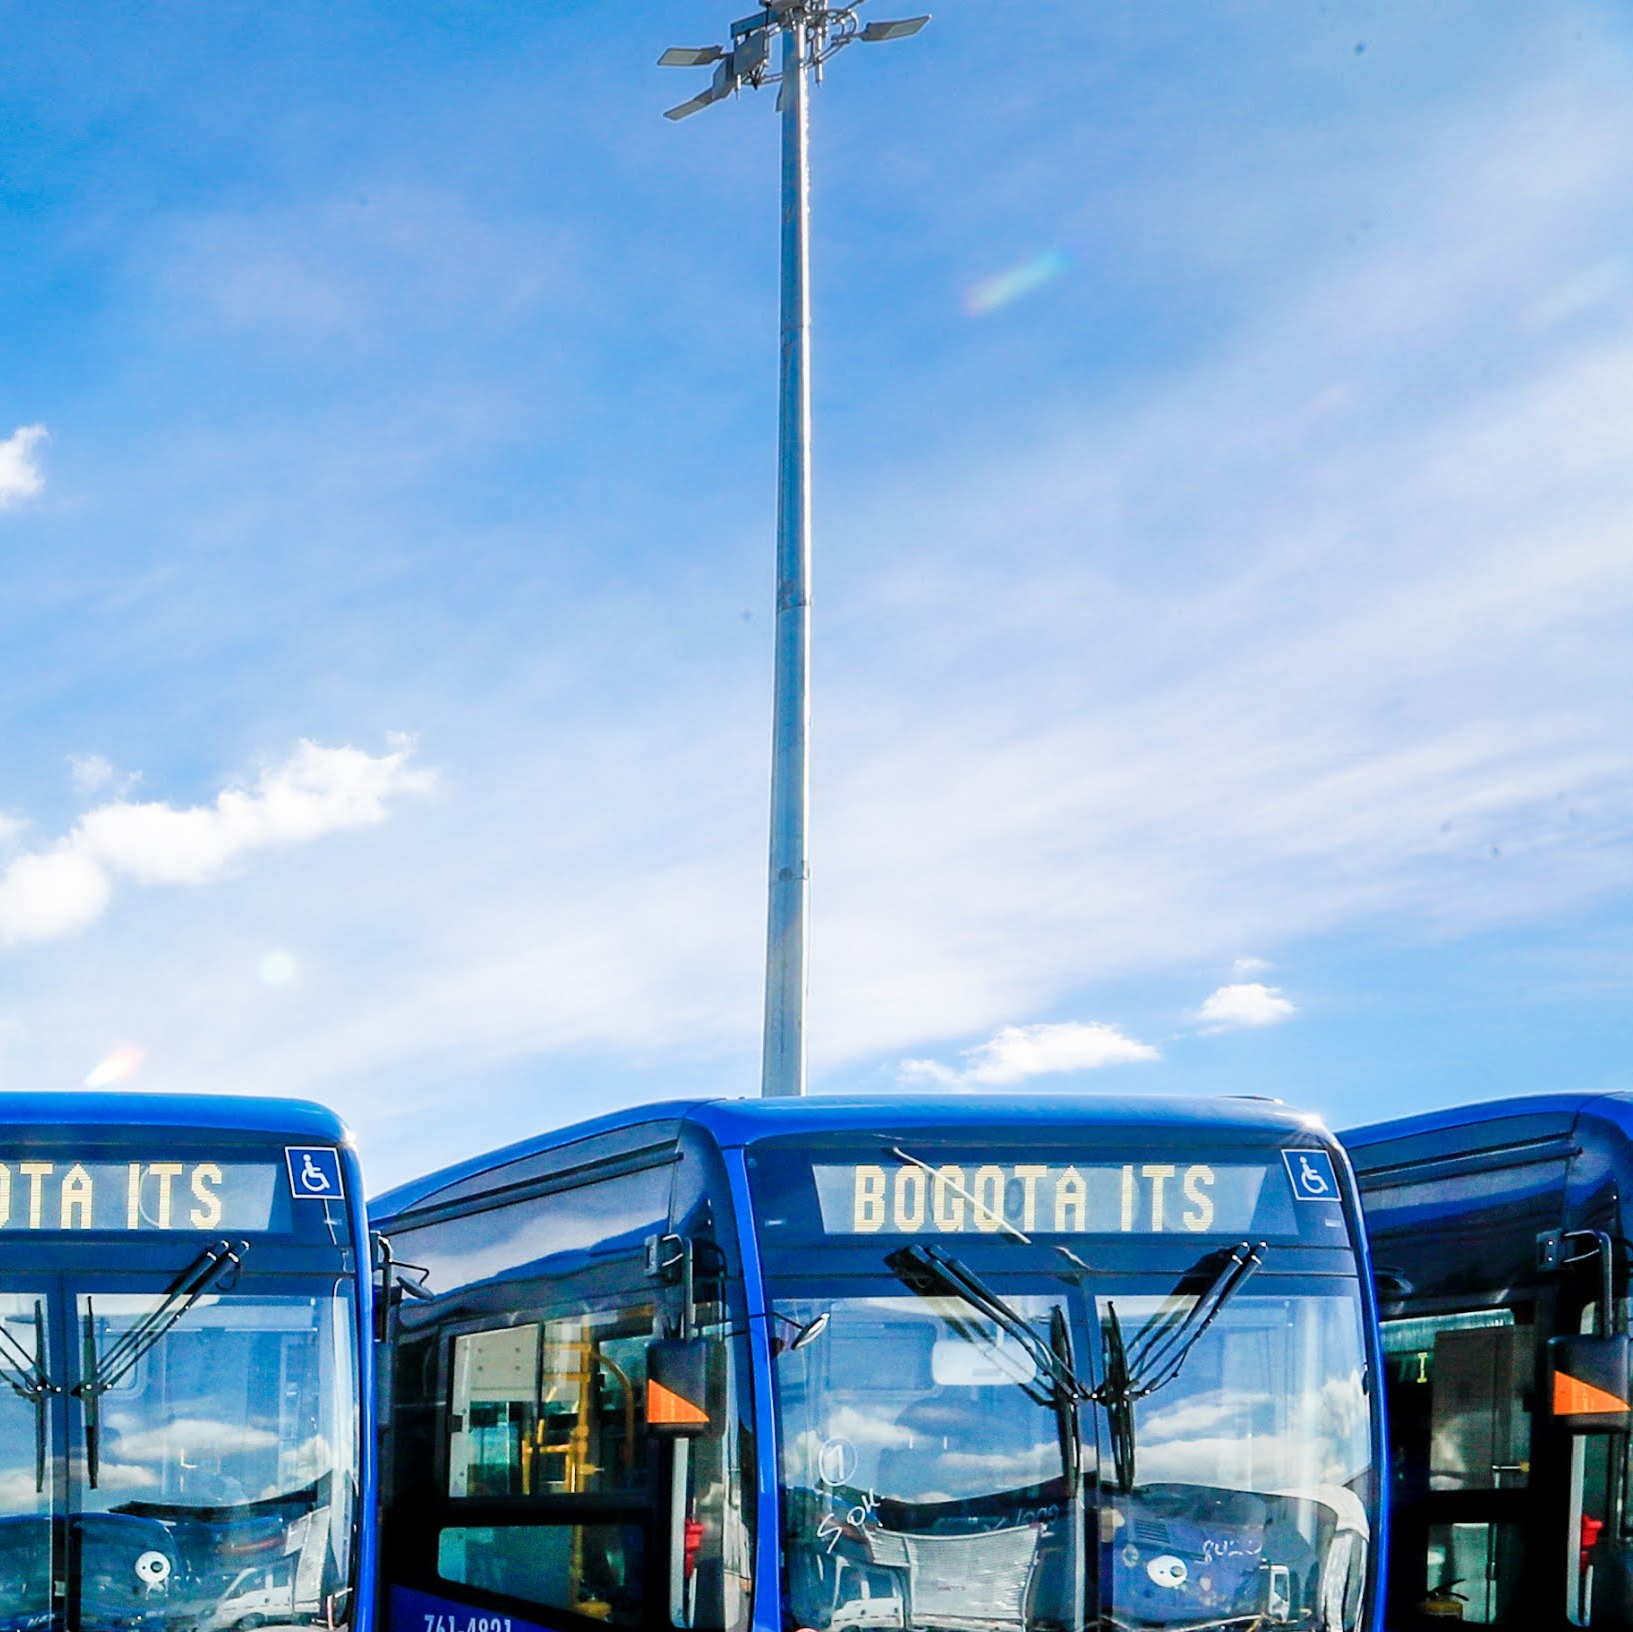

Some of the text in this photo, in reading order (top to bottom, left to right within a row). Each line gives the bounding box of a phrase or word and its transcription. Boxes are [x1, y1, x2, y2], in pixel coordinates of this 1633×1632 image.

[125, 1160, 225, 1231] ITS
[852, 1163, 1216, 1234] BOGOTA ITS
